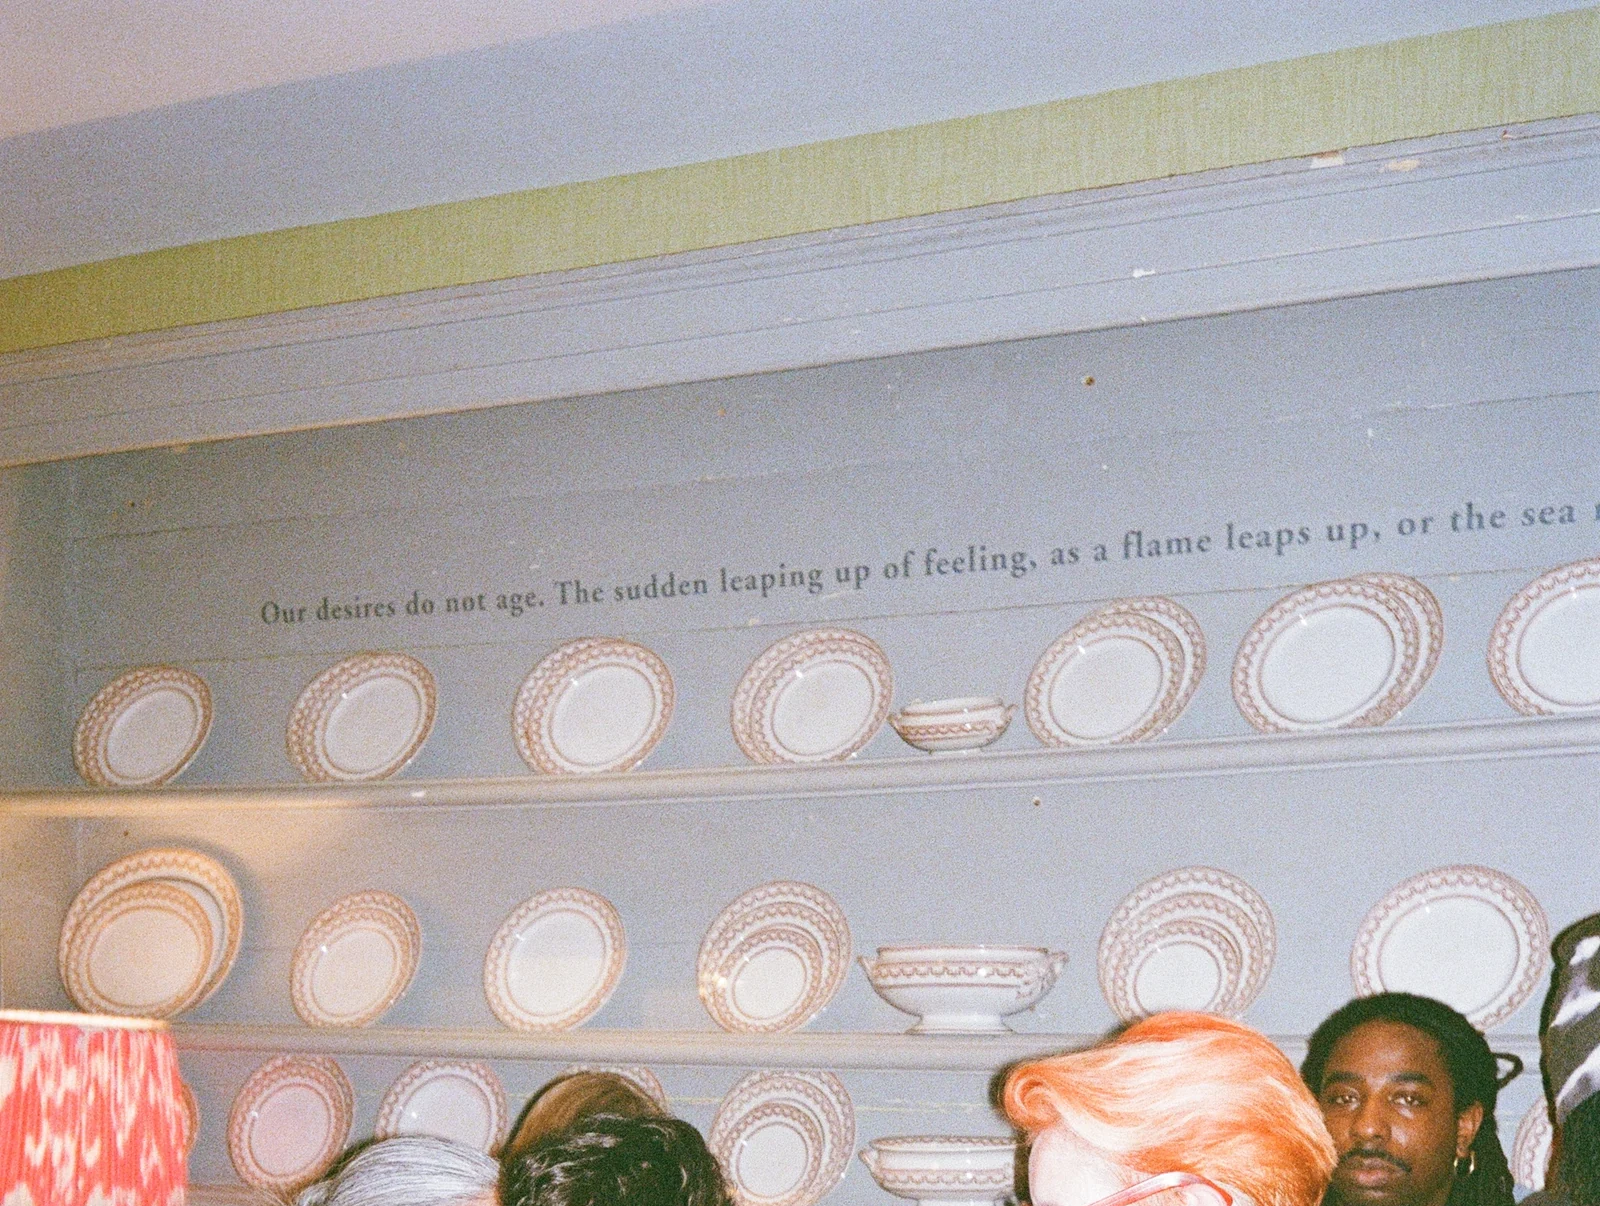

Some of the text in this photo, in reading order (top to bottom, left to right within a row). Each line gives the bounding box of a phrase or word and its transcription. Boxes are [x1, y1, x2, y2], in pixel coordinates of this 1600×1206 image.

[260, 600, 306, 623] Our
[315, 595, 397, 620] desires
[404, 589, 436, 616] do
[445, 592, 487, 613] not
[496, 591, 546, 618] age.
[556, 580, 605, 607] The
[613, 573, 708, 602] sudden
[719, 563, 825, 596] leaping
[834, 564, 872, 590] up
[882, 550, 917, 580] of
[923, 542, 1038, 579] feeling,
[1049, 546, 1081, 567] as
[1092, 544, 1109, 563] a
[1120, 528, 1213, 561] flame
[1225, 521, 1312, 557] leaps
[1325, 522, 1382, 553] up,
[1395, 516, 1435, 537] or
[1448, 501, 1507, 534] the
[1520, 505, 1576, 527] sea
